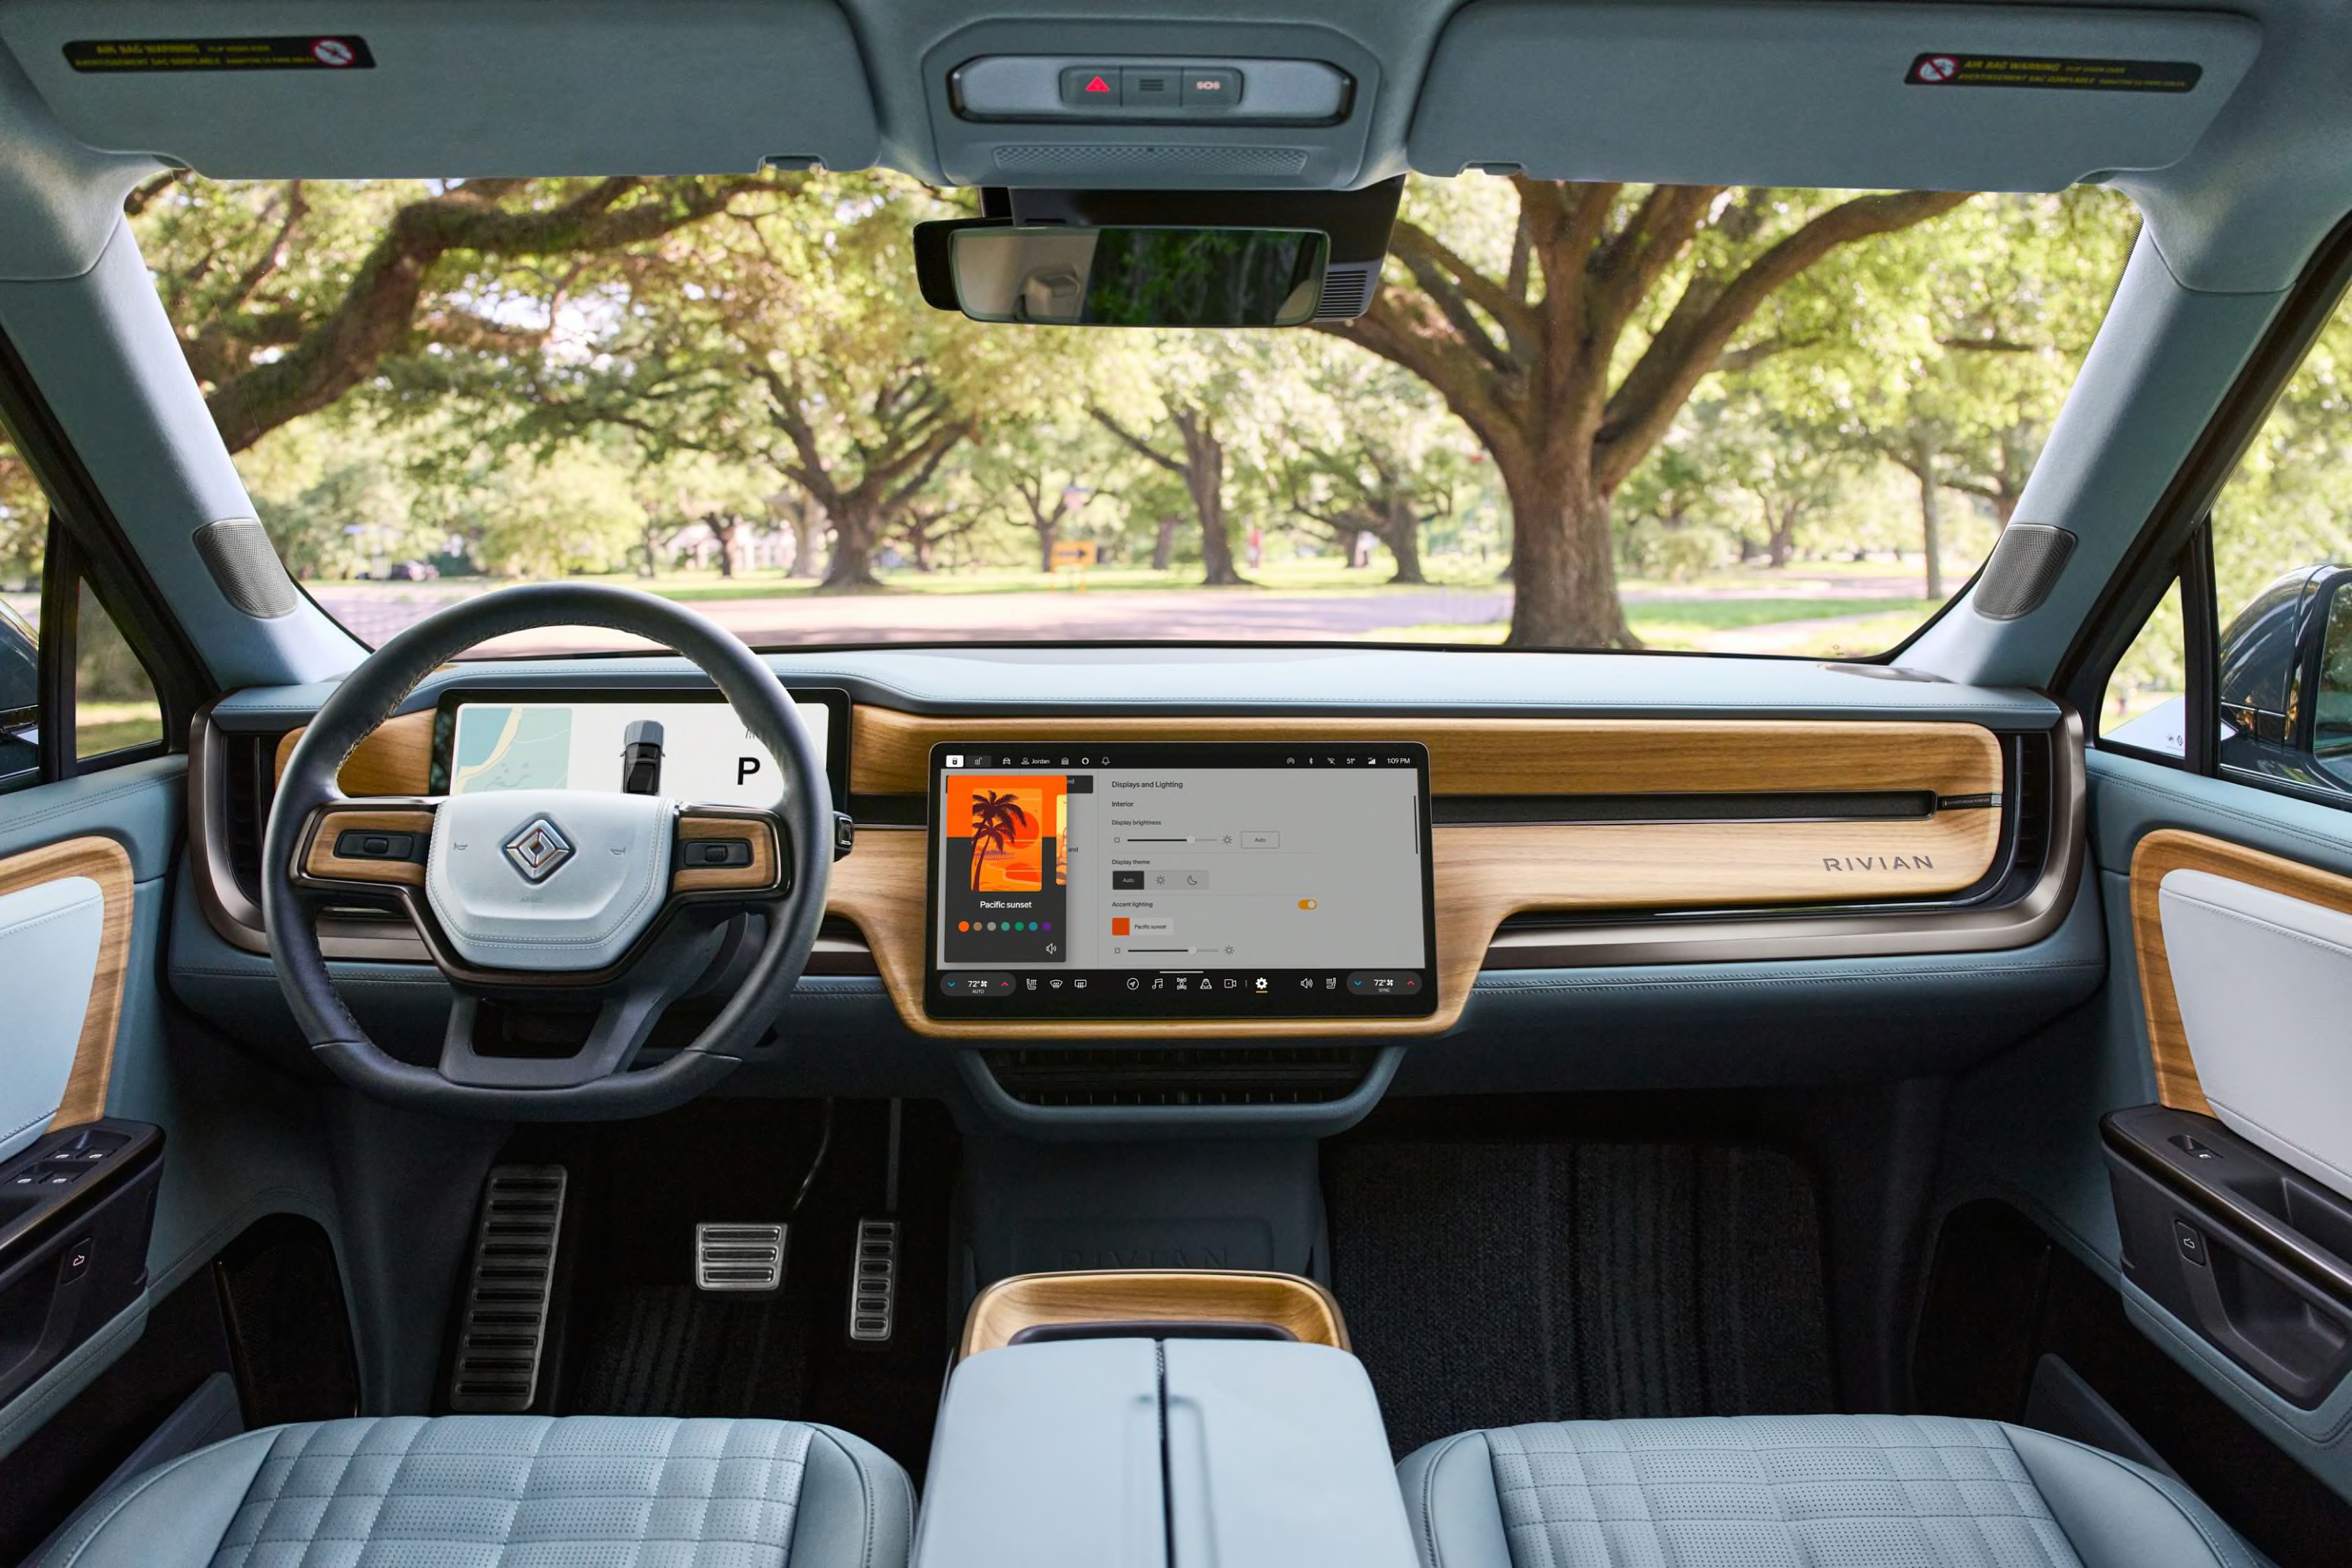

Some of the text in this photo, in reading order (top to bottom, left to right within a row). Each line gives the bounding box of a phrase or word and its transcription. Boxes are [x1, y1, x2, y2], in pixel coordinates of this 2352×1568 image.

[118, 44, 144, 54] BAG
[1964, 60, 1984, 69] AIR
[1984, 60, 2009, 70] BAG
[1196, 81, 1220, 90] SOS
[1031, 757, 1050, 765] Jordan
[737, 757, 760, 786] P
[1111, 781, 1140, 789] Displays
[1155, 781, 1183, 790] Lighting
[1822, 855, 1934, 871] RIVIAN
[980, 901, 1006, 909] Pacific
